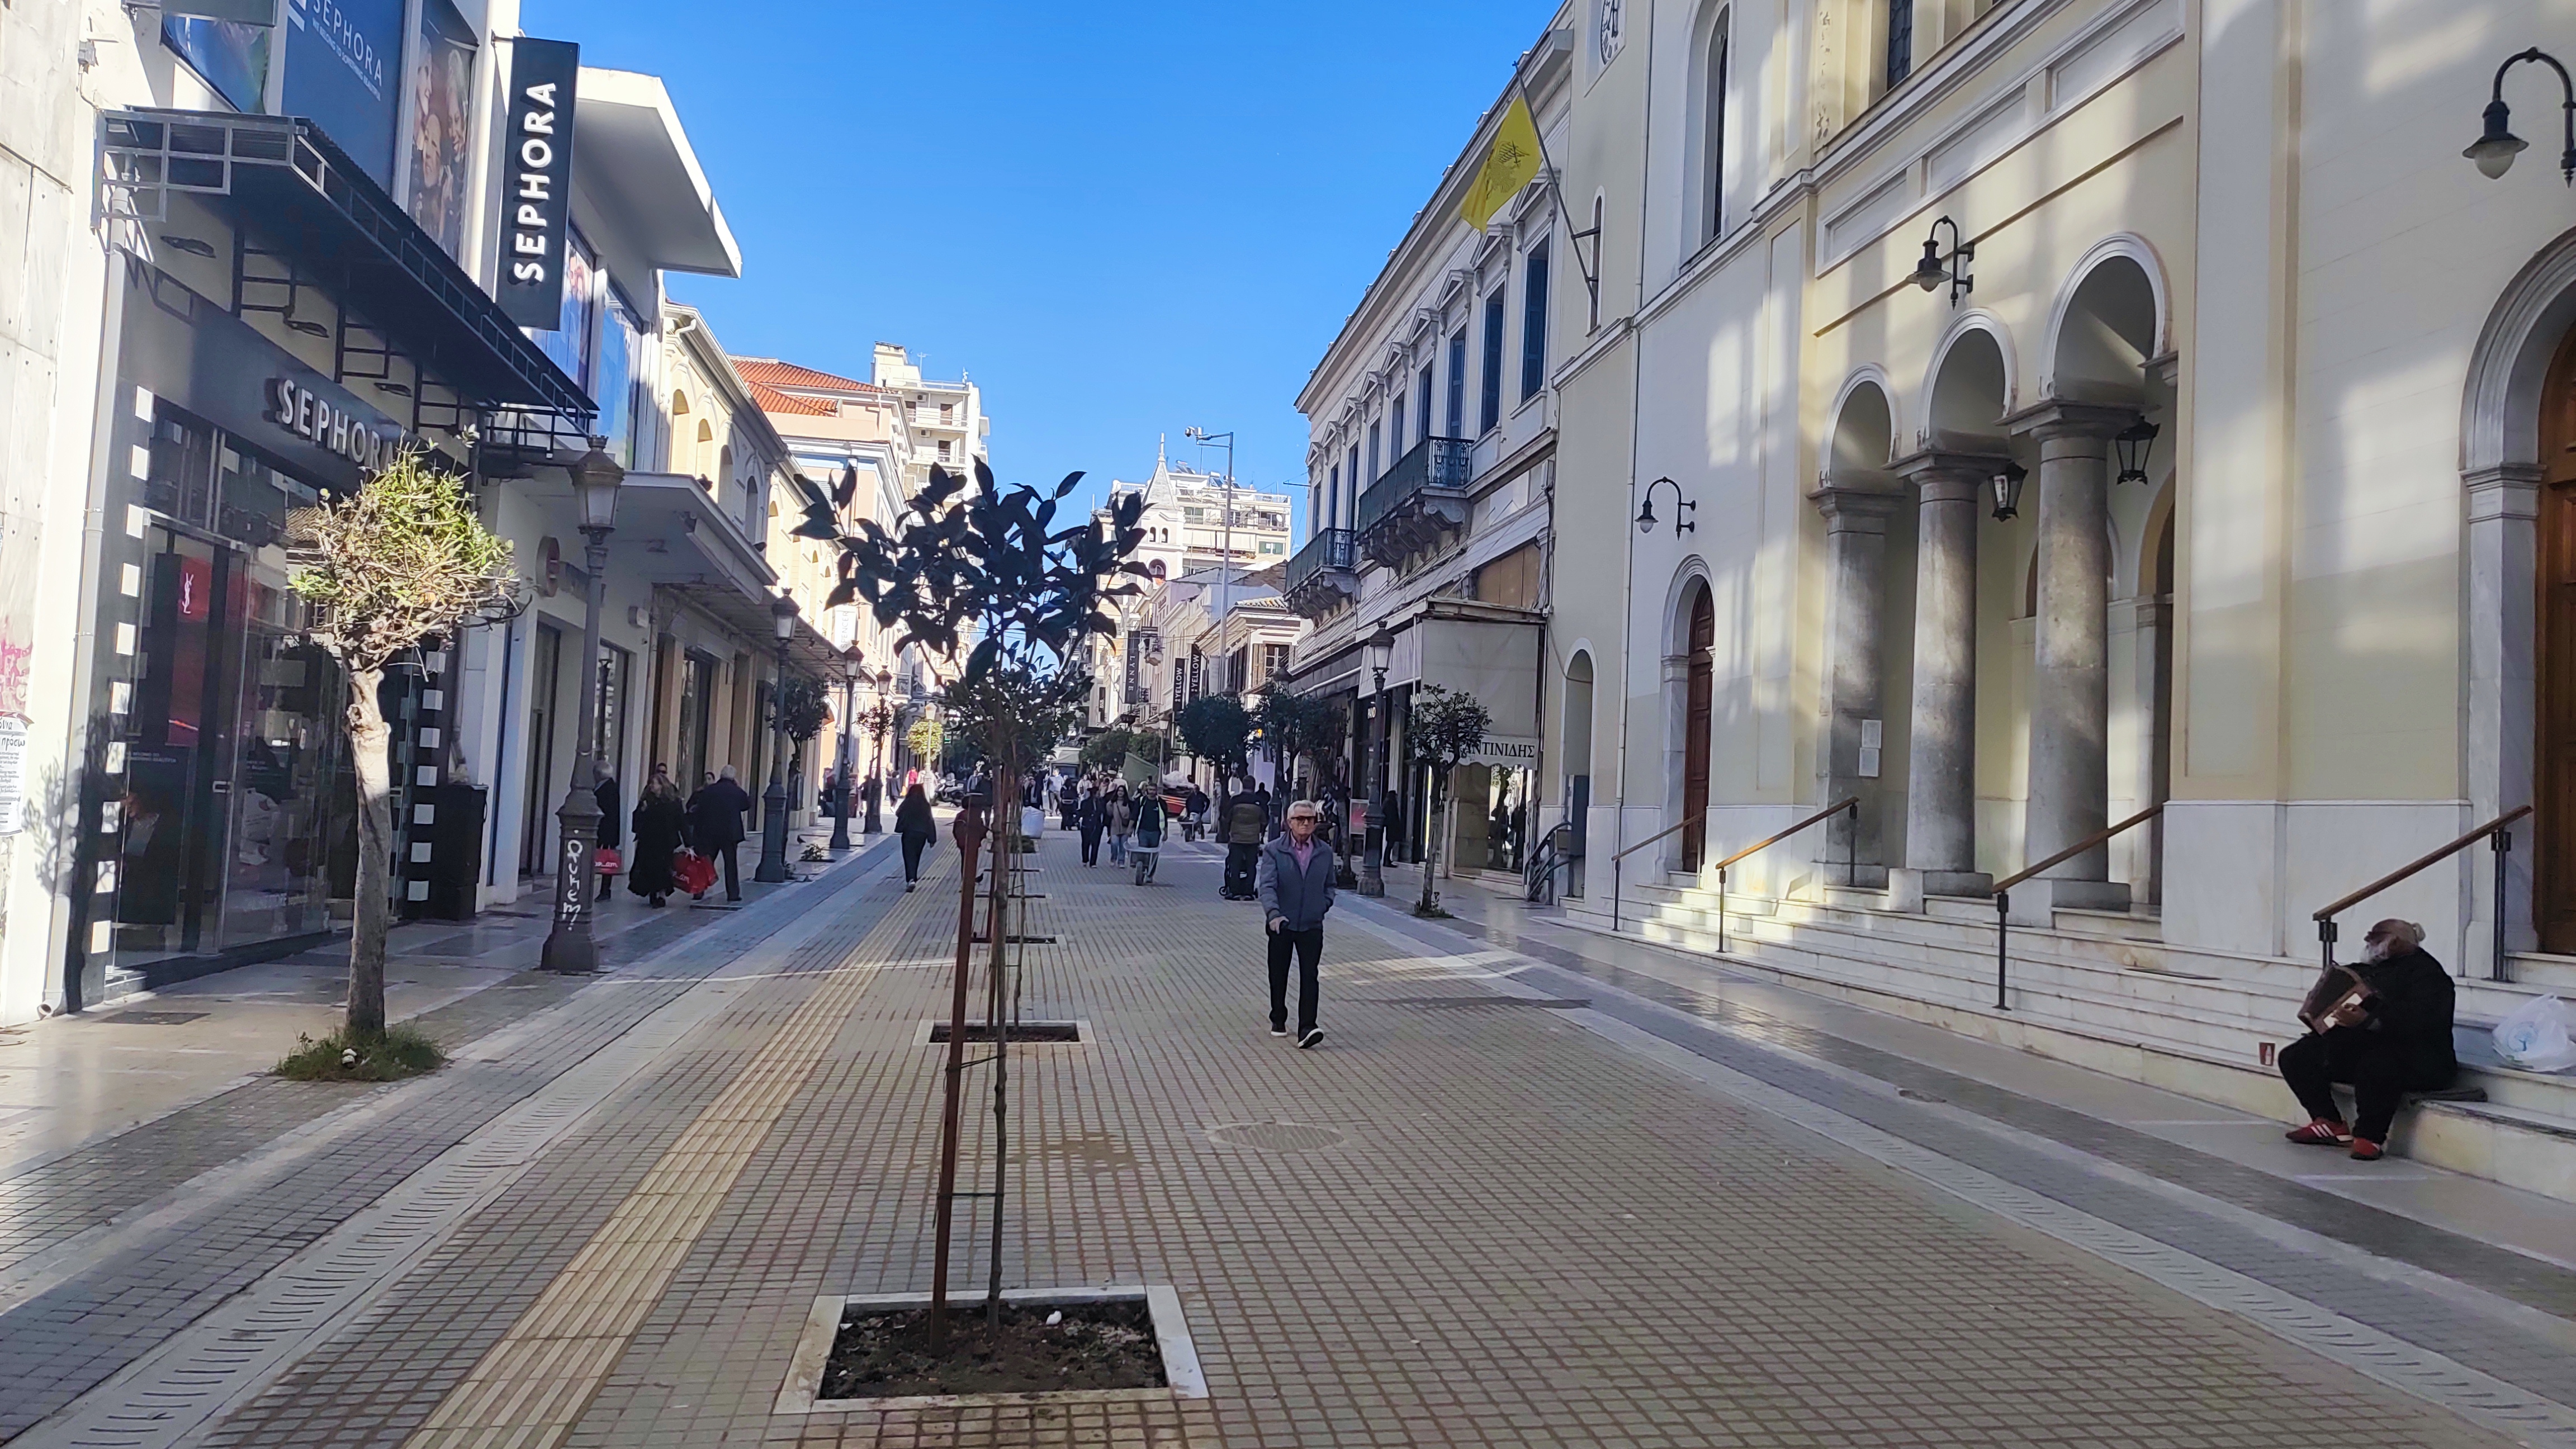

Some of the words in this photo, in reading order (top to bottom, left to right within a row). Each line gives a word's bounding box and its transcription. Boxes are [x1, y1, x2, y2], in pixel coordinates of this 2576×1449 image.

[313, 0, 382, 87] SEPHORA
[513, 83, 557, 282] SEPHORA
[278, 380, 394, 471] SEPHORA
[840, 611, 849, 648] SPENCER
[1190, 654, 1200, 688] YELLOW
[1367, 707, 1376, 719] PAND
[1459, 737, 1536, 758] ΑΝΤΙΝΙΔΗΣ
